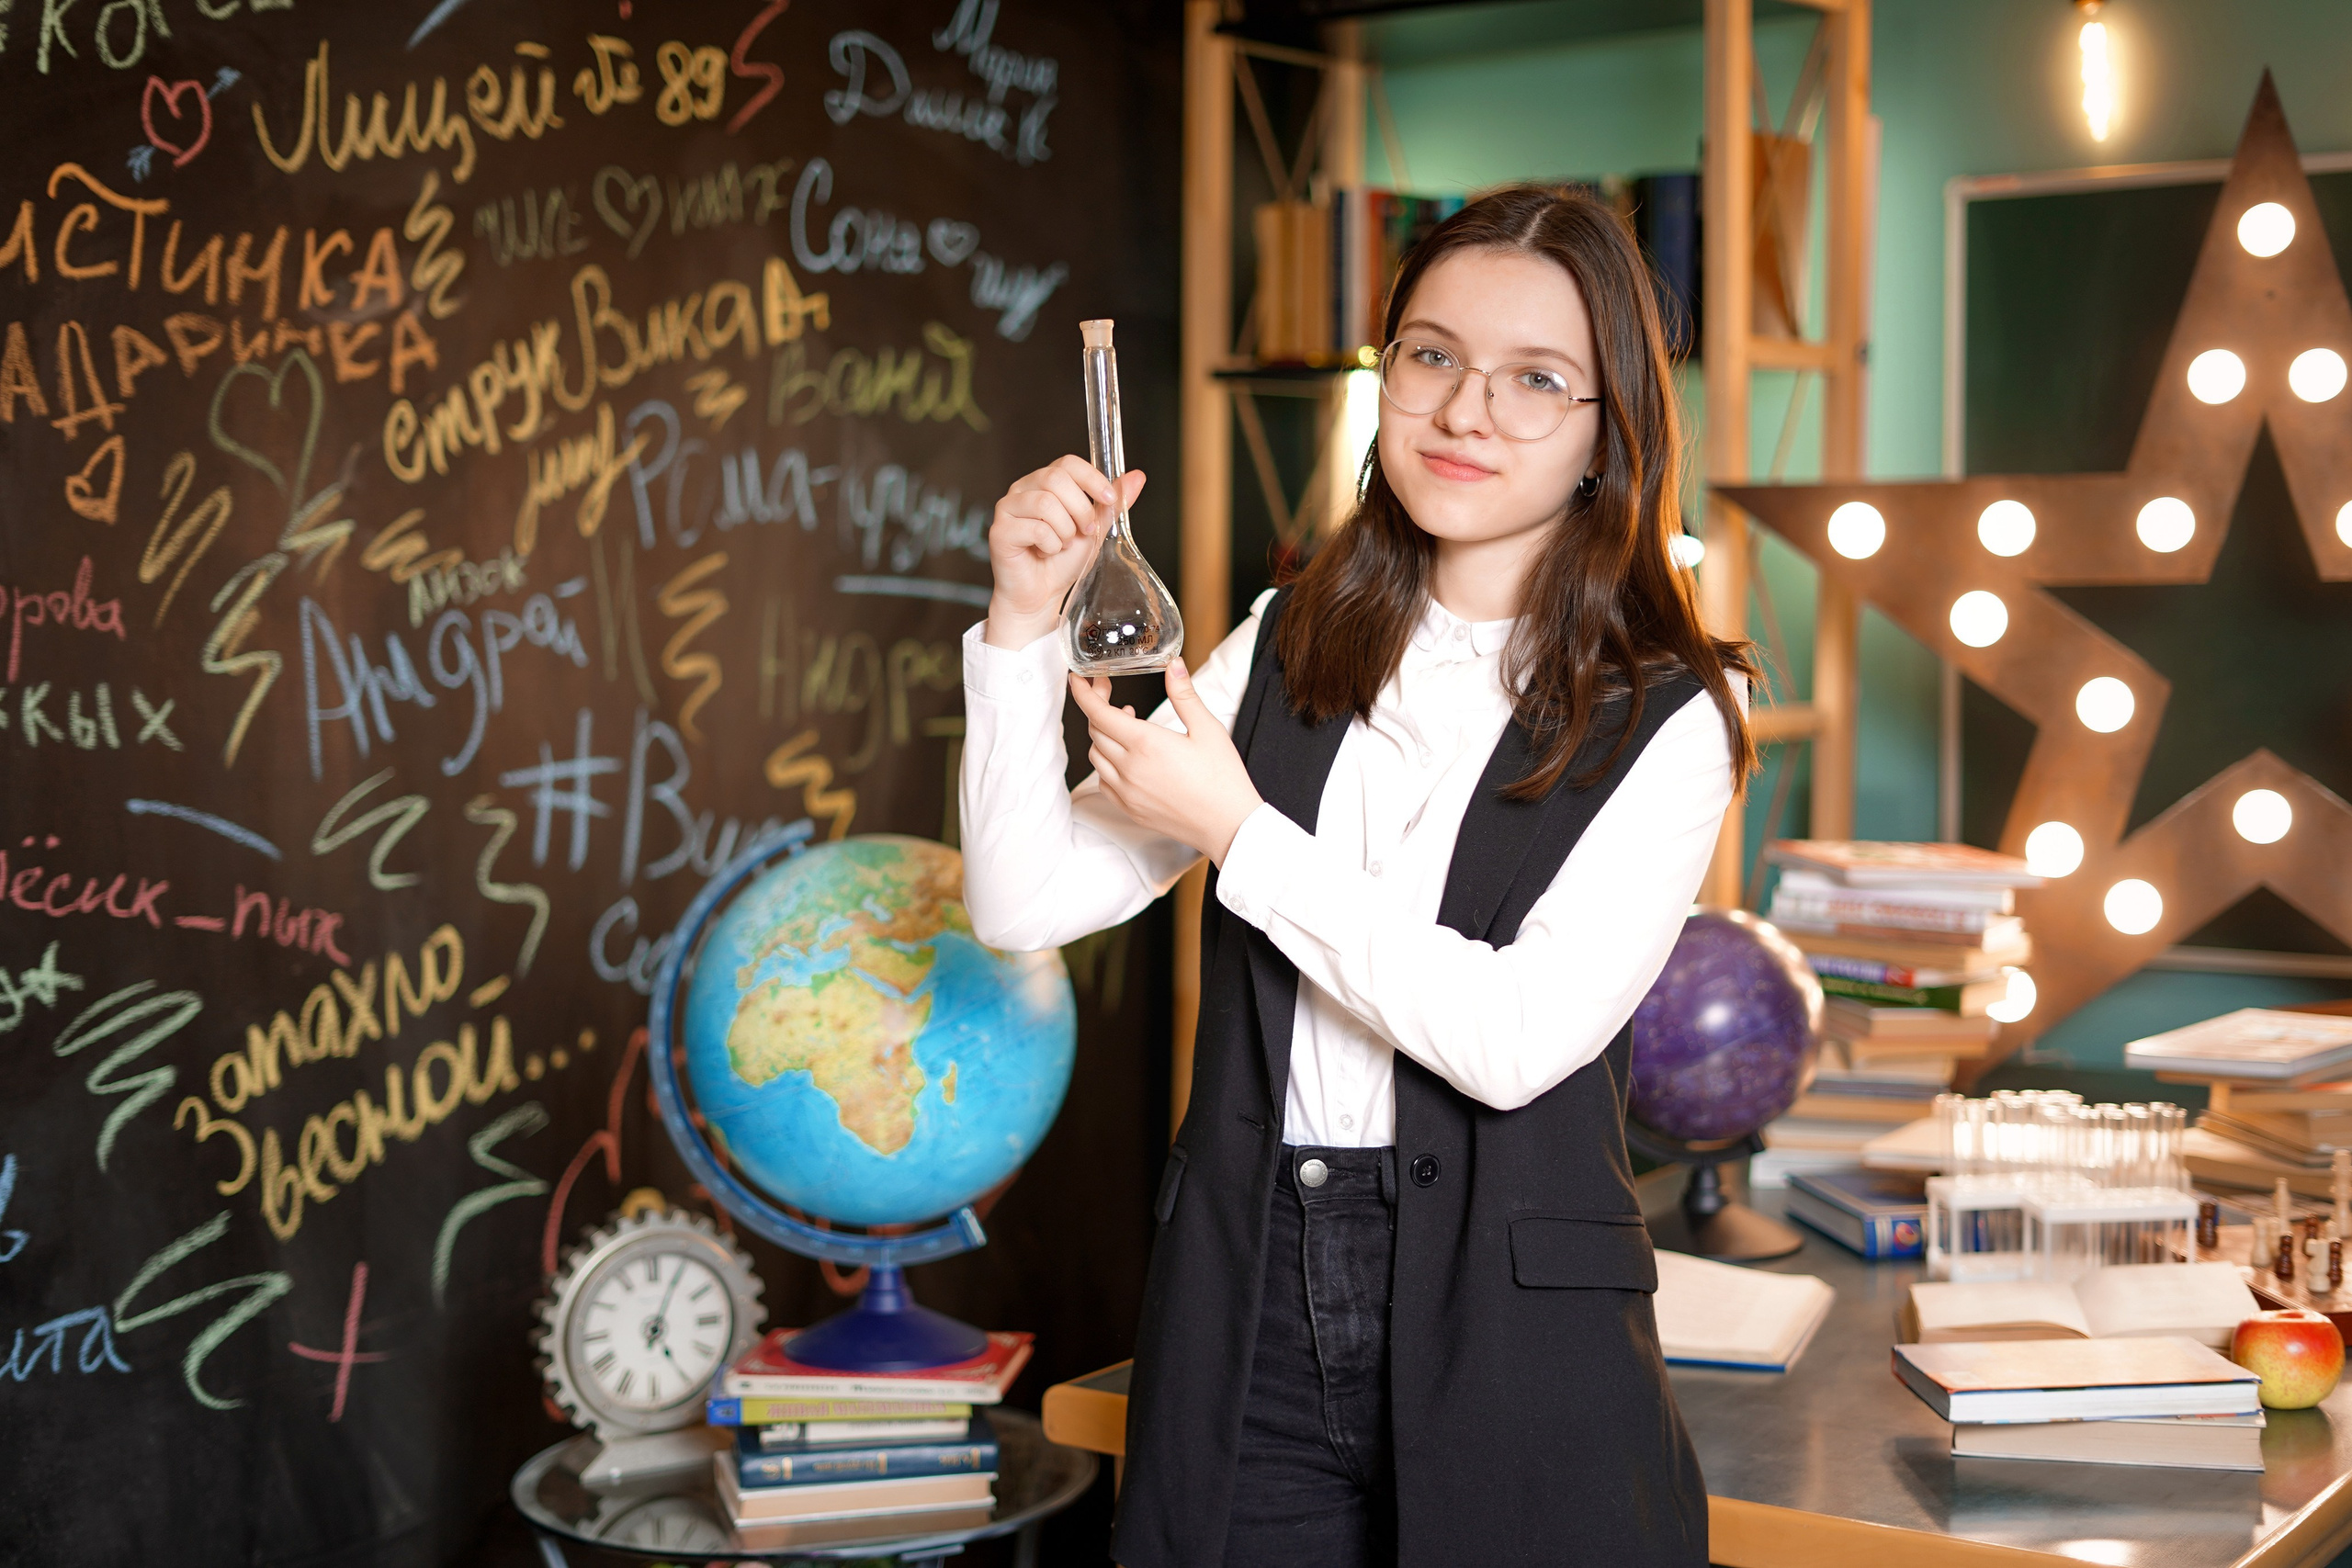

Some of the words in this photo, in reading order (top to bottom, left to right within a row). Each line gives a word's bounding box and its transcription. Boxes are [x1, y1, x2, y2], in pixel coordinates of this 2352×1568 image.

[253, 39, 564, 183] Лицей
[656, 40, 729, 126] 89
[0, 555, 127, 683] рова
